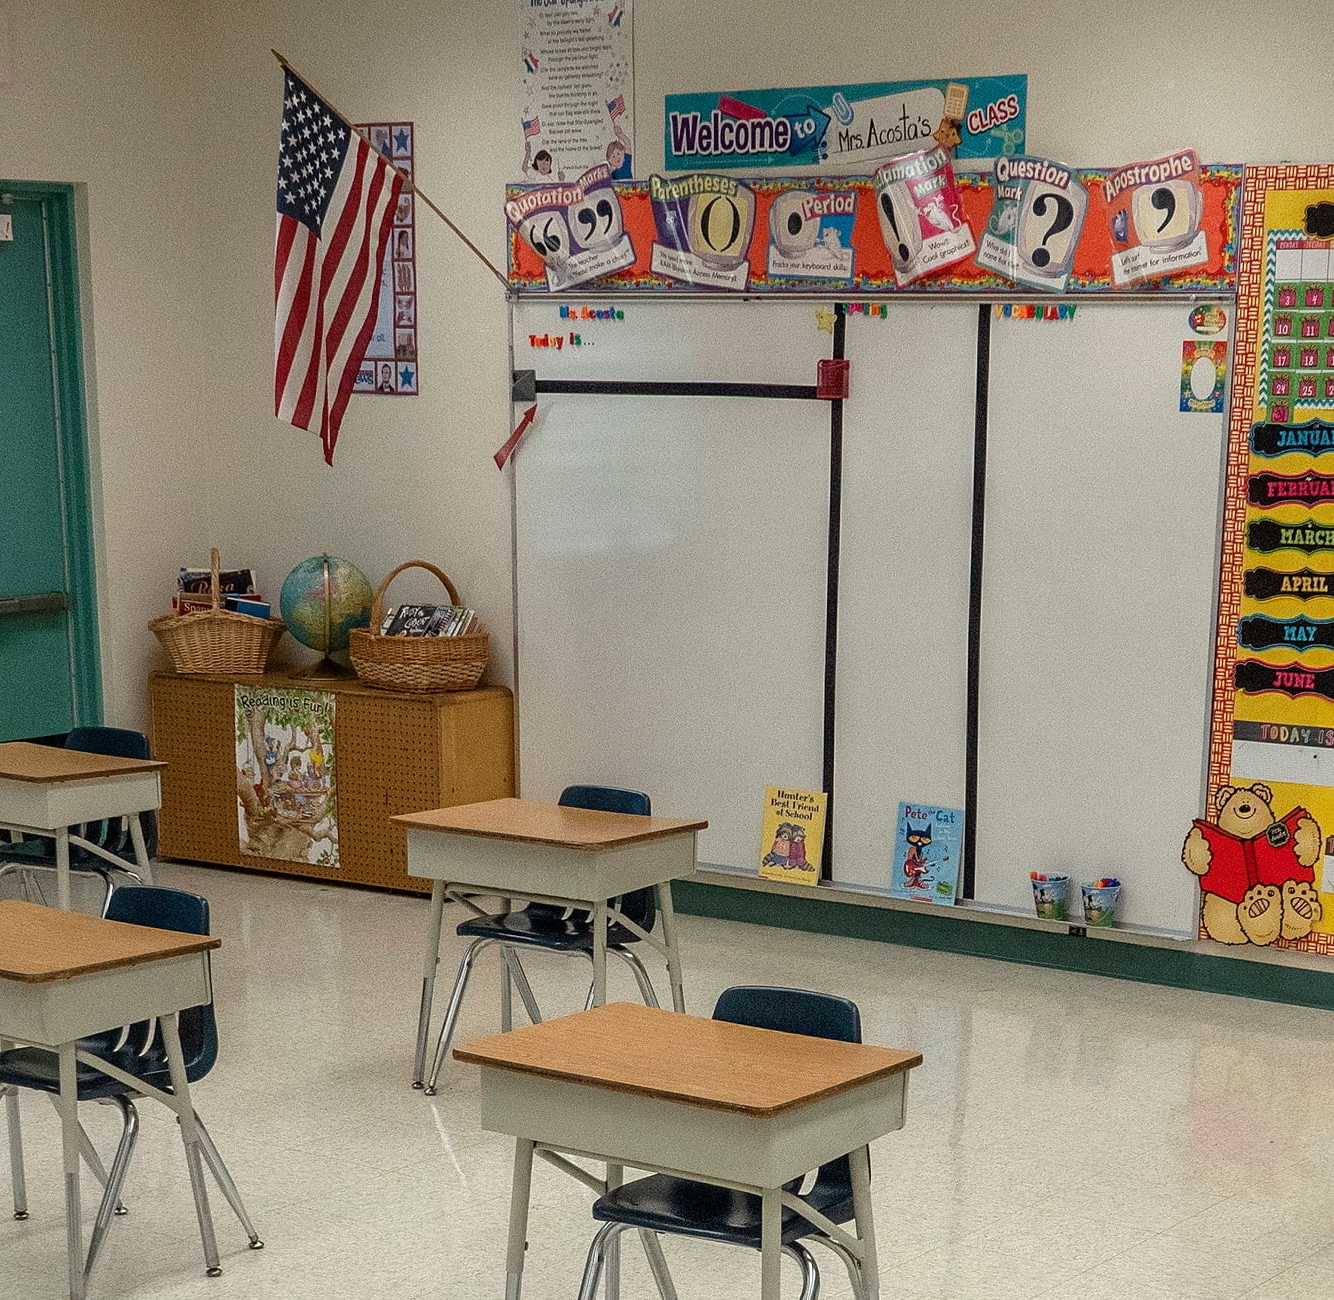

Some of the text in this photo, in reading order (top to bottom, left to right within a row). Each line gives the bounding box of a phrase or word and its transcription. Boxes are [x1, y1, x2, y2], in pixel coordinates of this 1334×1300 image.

[670, 95, 1020, 156] Welcome to Mrs. Acosta's CLASS
[996, 158, 1070, 187] Question
[1104, 156, 1193, 202] Apostrophe
[505, 167, 609, 222] Quotation Marks
[651, 174, 739, 200] Parentheses
[914, 174, 947, 198] Mark
[997, 185, 1022, 201] Mark
[802, 192, 856, 220] Period
[1285, 295, 1290, 305] 3
[1312, 294, 1318, 304] 4
[581, 306, 624, 320] Acosta
[994, 304, 1077, 321] VOCABULARY
[1277, 325, 1288, 334] 10
[1306, 326, 1315, 336] 11
[529, 334, 564, 350] Today
[1278, 356, 1286, 366] 17
[1305, 356, 1314, 366] 18
[1277, 383, 1287, 393] 24
[1303, 385, 1313, 395] 25
[1281, 576, 1328, 593] APRIL
[1283, 625, 1317, 642] MAY
[1272, 671, 1315, 689] JUNE
[240, 694, 329, 717] Reading is Fun!
[1260, 724, 1310, 743] TODAY
[777, 790, 815, 803] Hunter's
[771, 798, 820, 813] Best Friend
[905, 805, 927, 820] Pete
[935, 810, 955, 823] Cat
[785, 809, 813, 821] School
